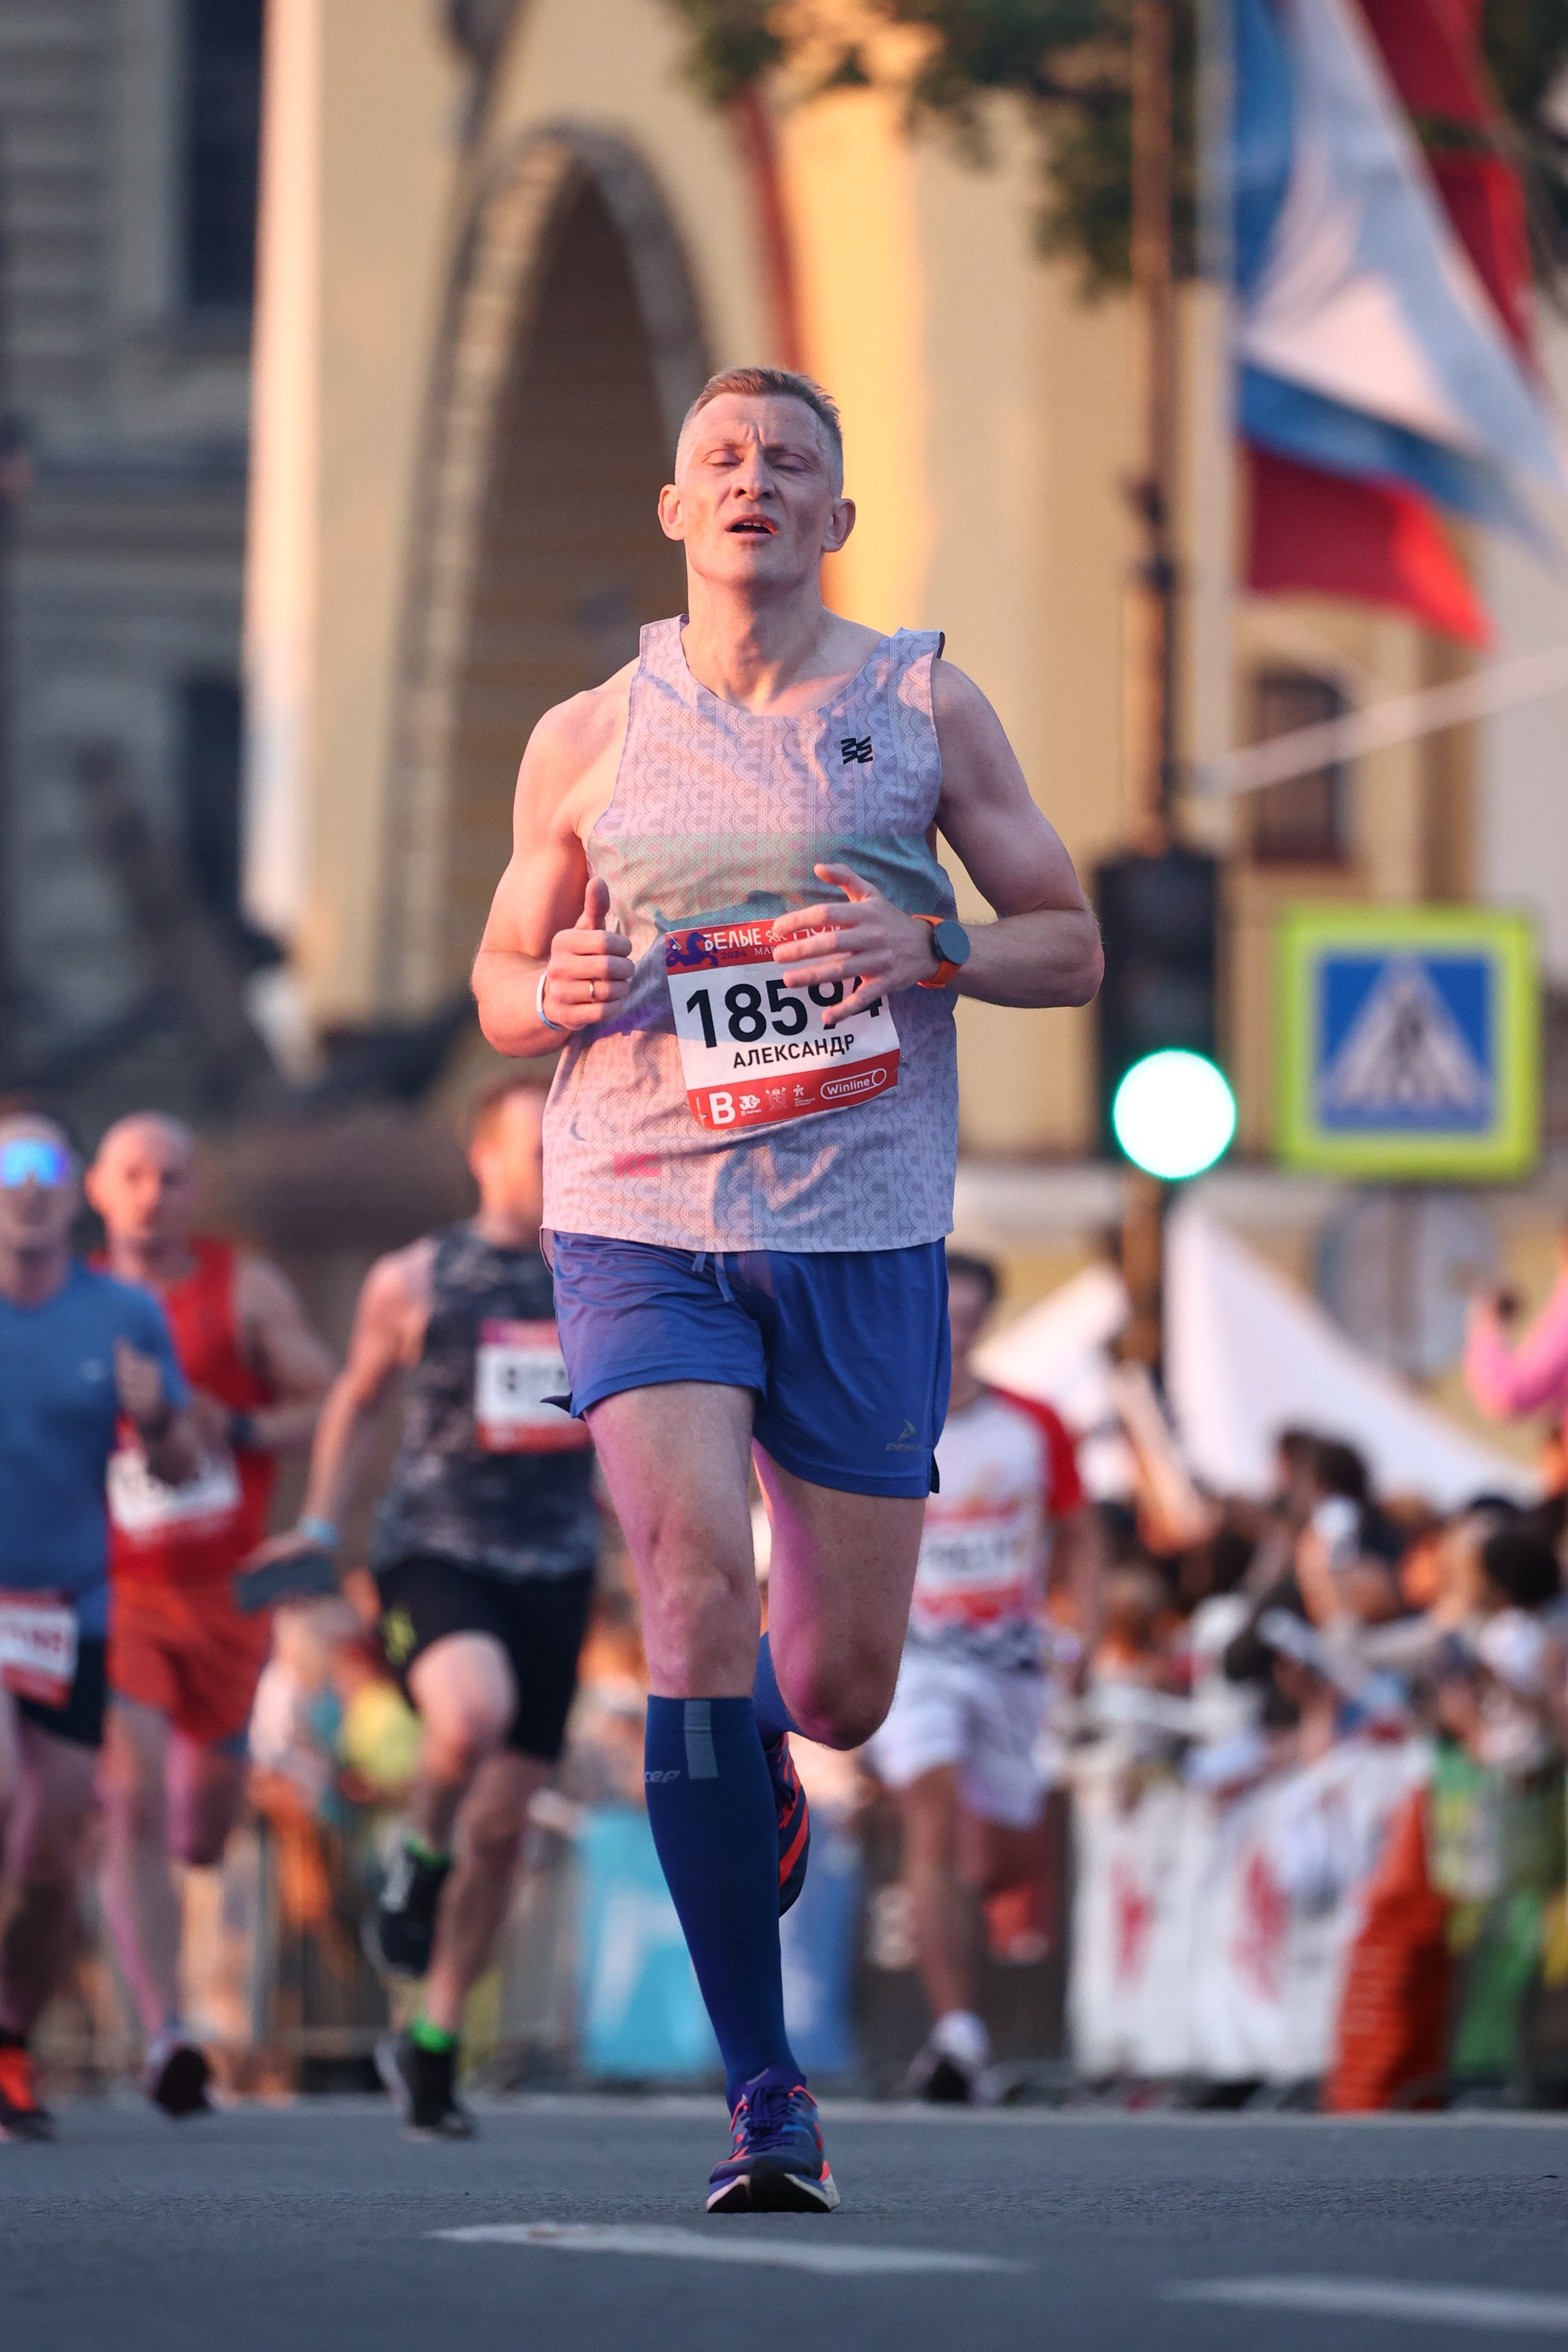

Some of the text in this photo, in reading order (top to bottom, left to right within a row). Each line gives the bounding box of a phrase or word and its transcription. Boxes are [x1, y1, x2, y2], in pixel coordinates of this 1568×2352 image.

[703, 928, 763, 952] БЕЛЫЕ
[733, 1034, 855, 1068] АЛЕКСАНДР
[827, 1078, 870, 1095] Winline
[709, 1091, 736, 1125] B
